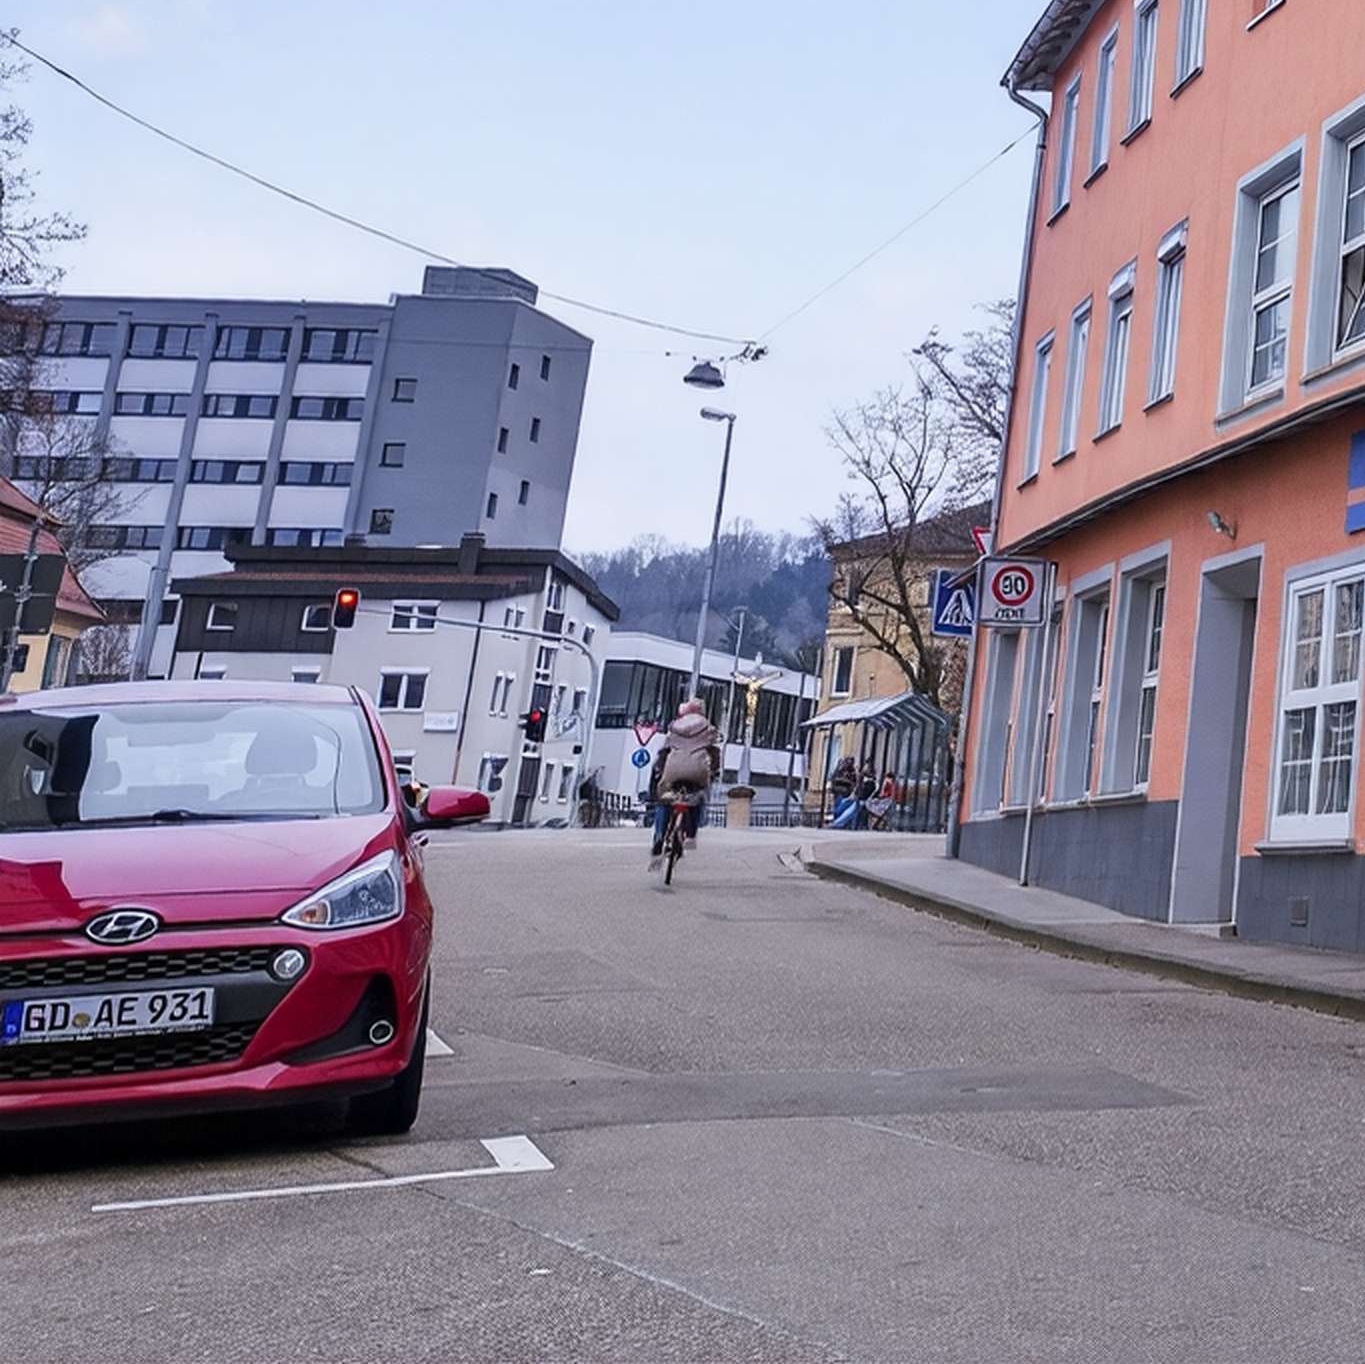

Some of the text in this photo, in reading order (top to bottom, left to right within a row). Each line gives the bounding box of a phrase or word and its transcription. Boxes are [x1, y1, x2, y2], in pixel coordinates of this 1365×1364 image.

[1002, 575, 1026, 596] 30
[93, 997, 138, 1028] AE
[148, 990, 209, 1025] 931
